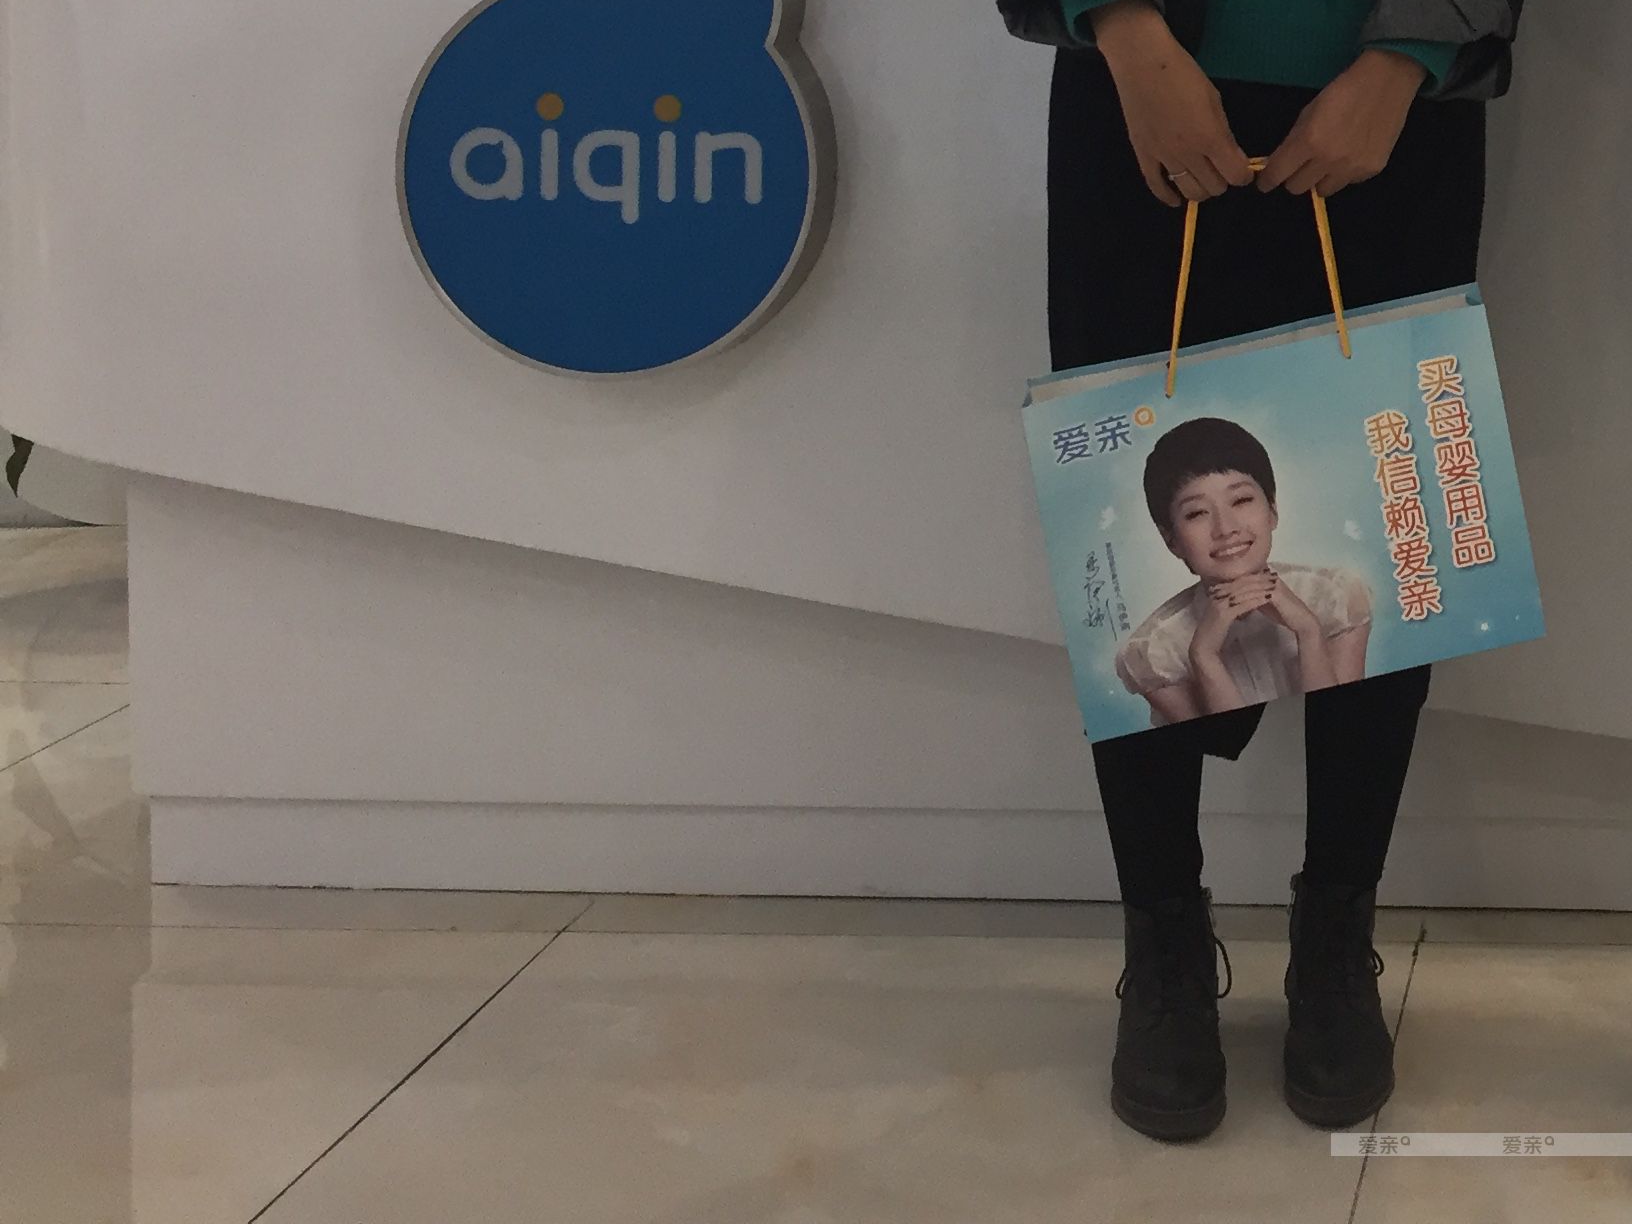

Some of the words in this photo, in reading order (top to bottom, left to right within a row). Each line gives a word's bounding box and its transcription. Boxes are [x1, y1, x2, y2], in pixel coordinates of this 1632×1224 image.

[450, 92, 763, 225] aiqin
[1053, 414, 1132, 465] 爱亲
[1364, 409, 1443, 622] 我信赖爱亲
[1417, 356, 1495, 568] 买母婴用品
